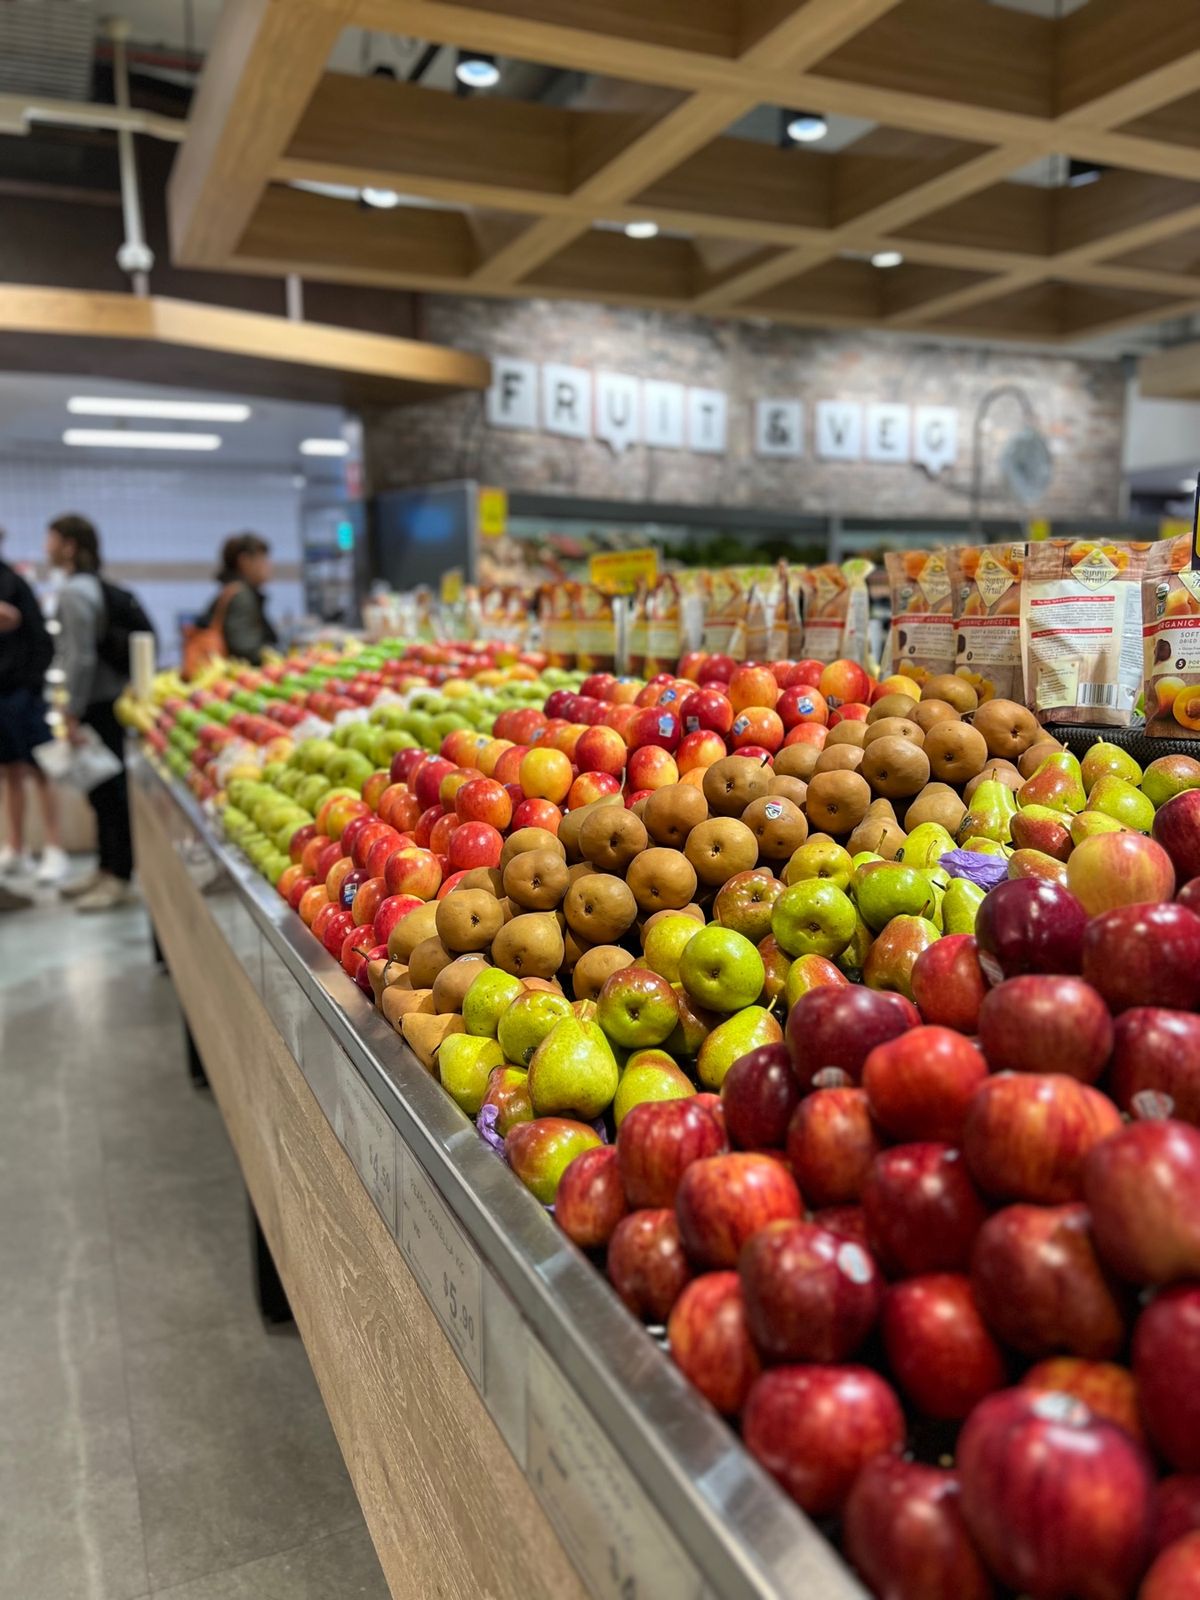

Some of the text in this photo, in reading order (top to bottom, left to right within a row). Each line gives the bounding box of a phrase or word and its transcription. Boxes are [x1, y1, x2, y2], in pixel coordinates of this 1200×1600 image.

[502, 372, 944, 450] FRUIT & VEG
[1082, 568, 1108, 578] Sunny
[443, 1271, 475, 1342] $5.90
